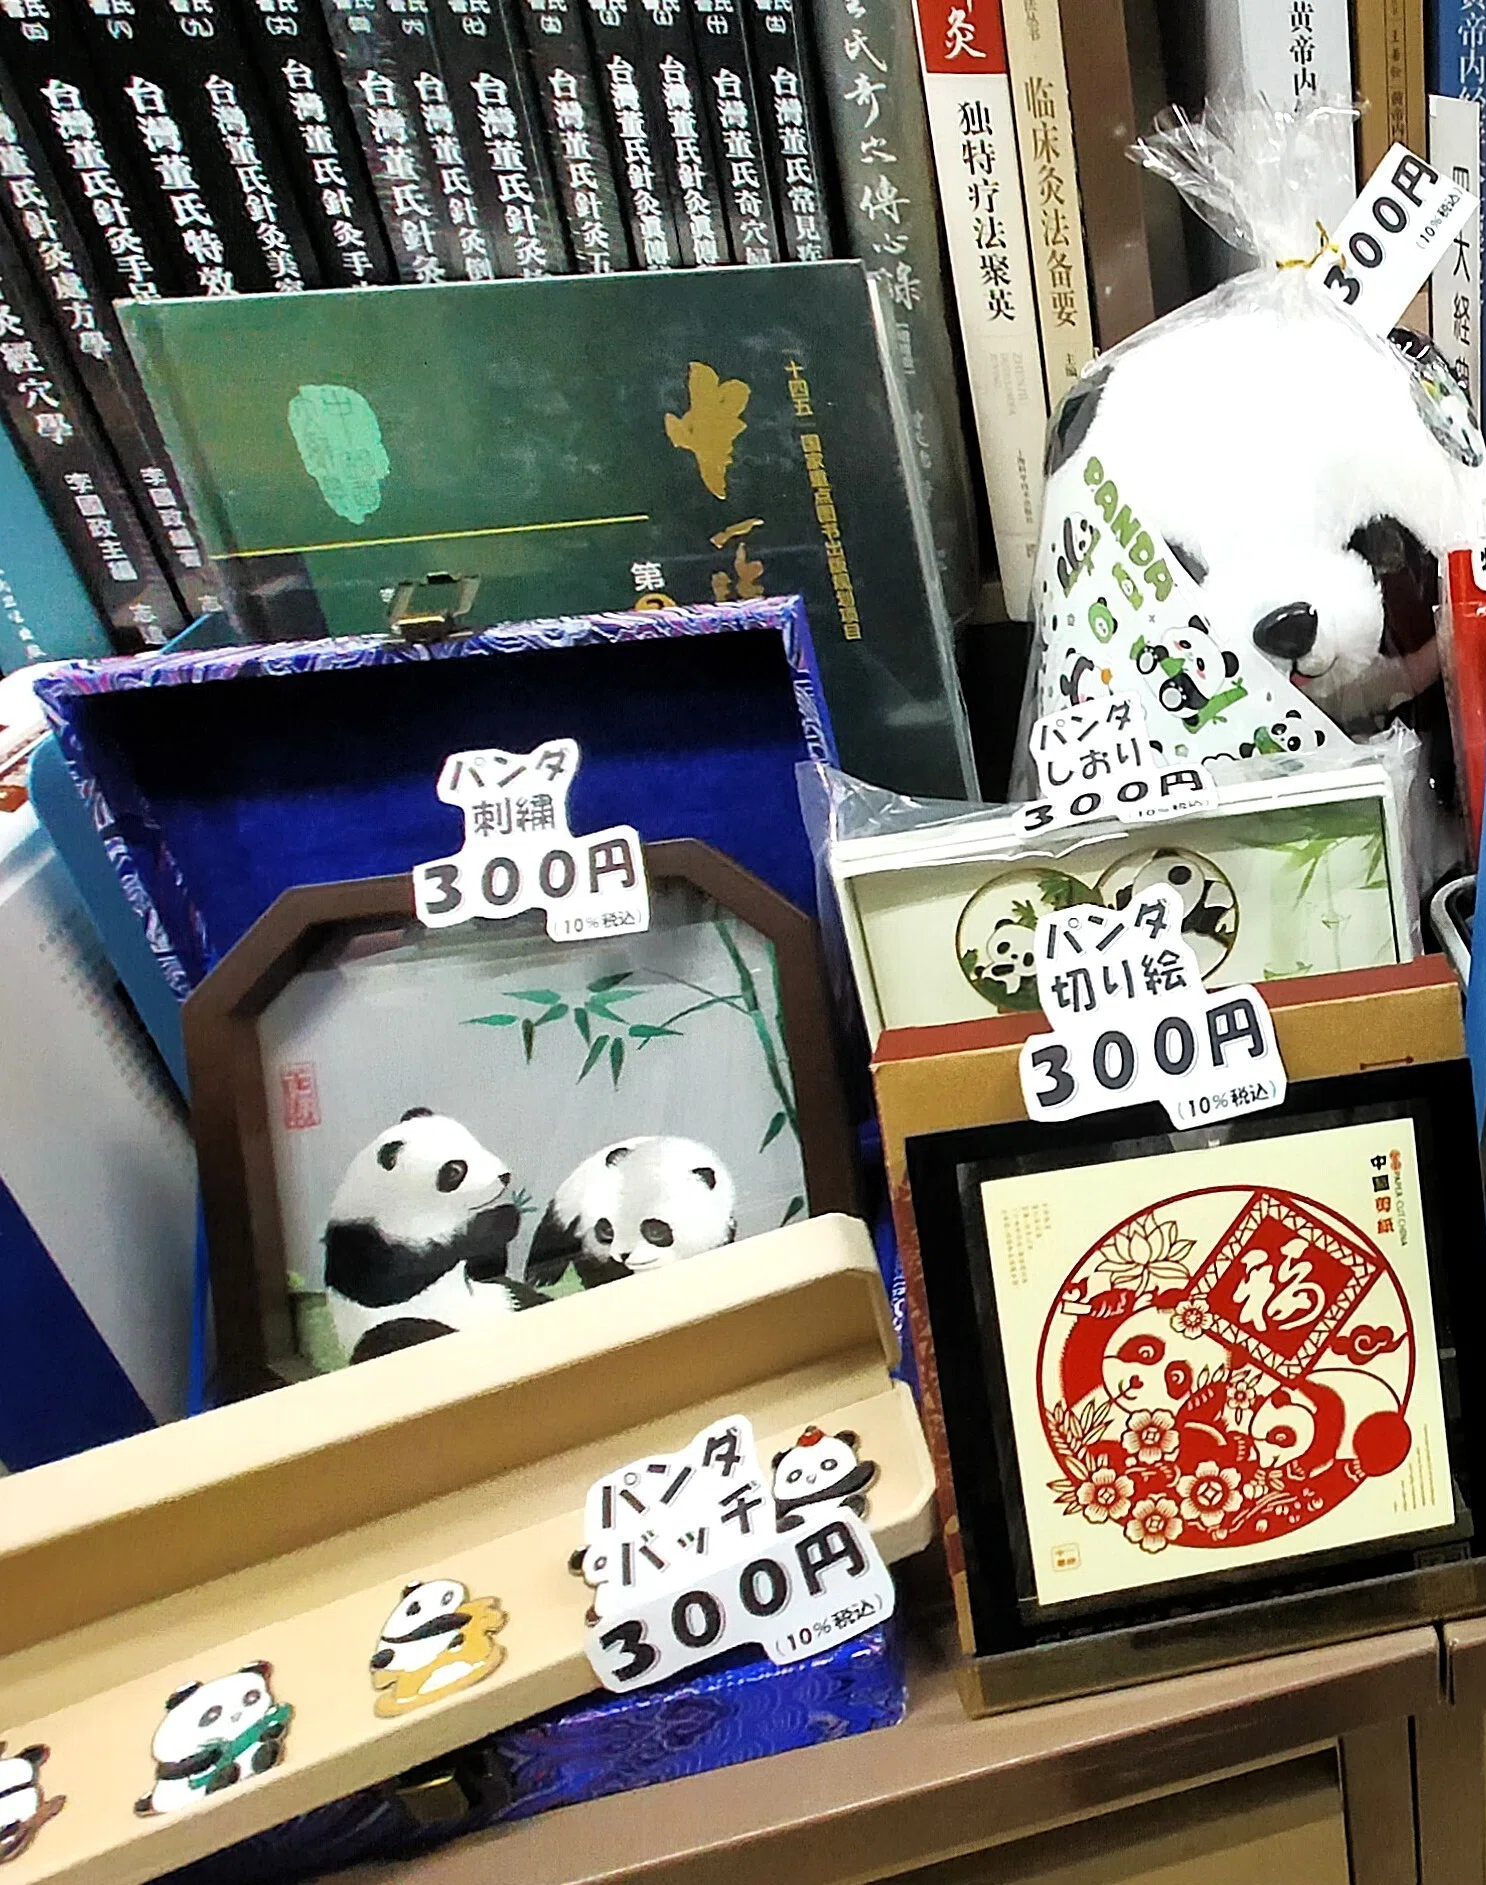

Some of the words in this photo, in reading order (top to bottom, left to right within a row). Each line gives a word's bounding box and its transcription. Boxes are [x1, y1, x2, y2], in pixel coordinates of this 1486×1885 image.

[1288, 0, 1318, 112] 黄帝内
[281, 58, 374, 287] 台灣董氏針灸手
[956, 100, 1017, 322] 独特疗法聚英
[1024, 76, 1078, 328] 临床灸法备要
[1323, 154, 1440, 306] 300円
[1083, 455, 1176, 603] PANDA
[449, 747, 570, 792] パンダ
[1039, 699, 1134, 751] パンダ
[1046, 737, 1143, 788] しおり
[1022, 769, 1205, 832] 300円
[423, 837, 637, 916] 300円
[1046, 897, 1170, 961] パンダ
[1050, 947, 1189, 1015] 切り絵
[1030, 997, 1266, 1109] 300円
[1176, 1079, 1278, 1122] (10%税込)
[1231, 1238, 1327, 1333] 福
[600, 1426, 742, 1530] パンダ
[599, 1520, 869, 1683] 300円
